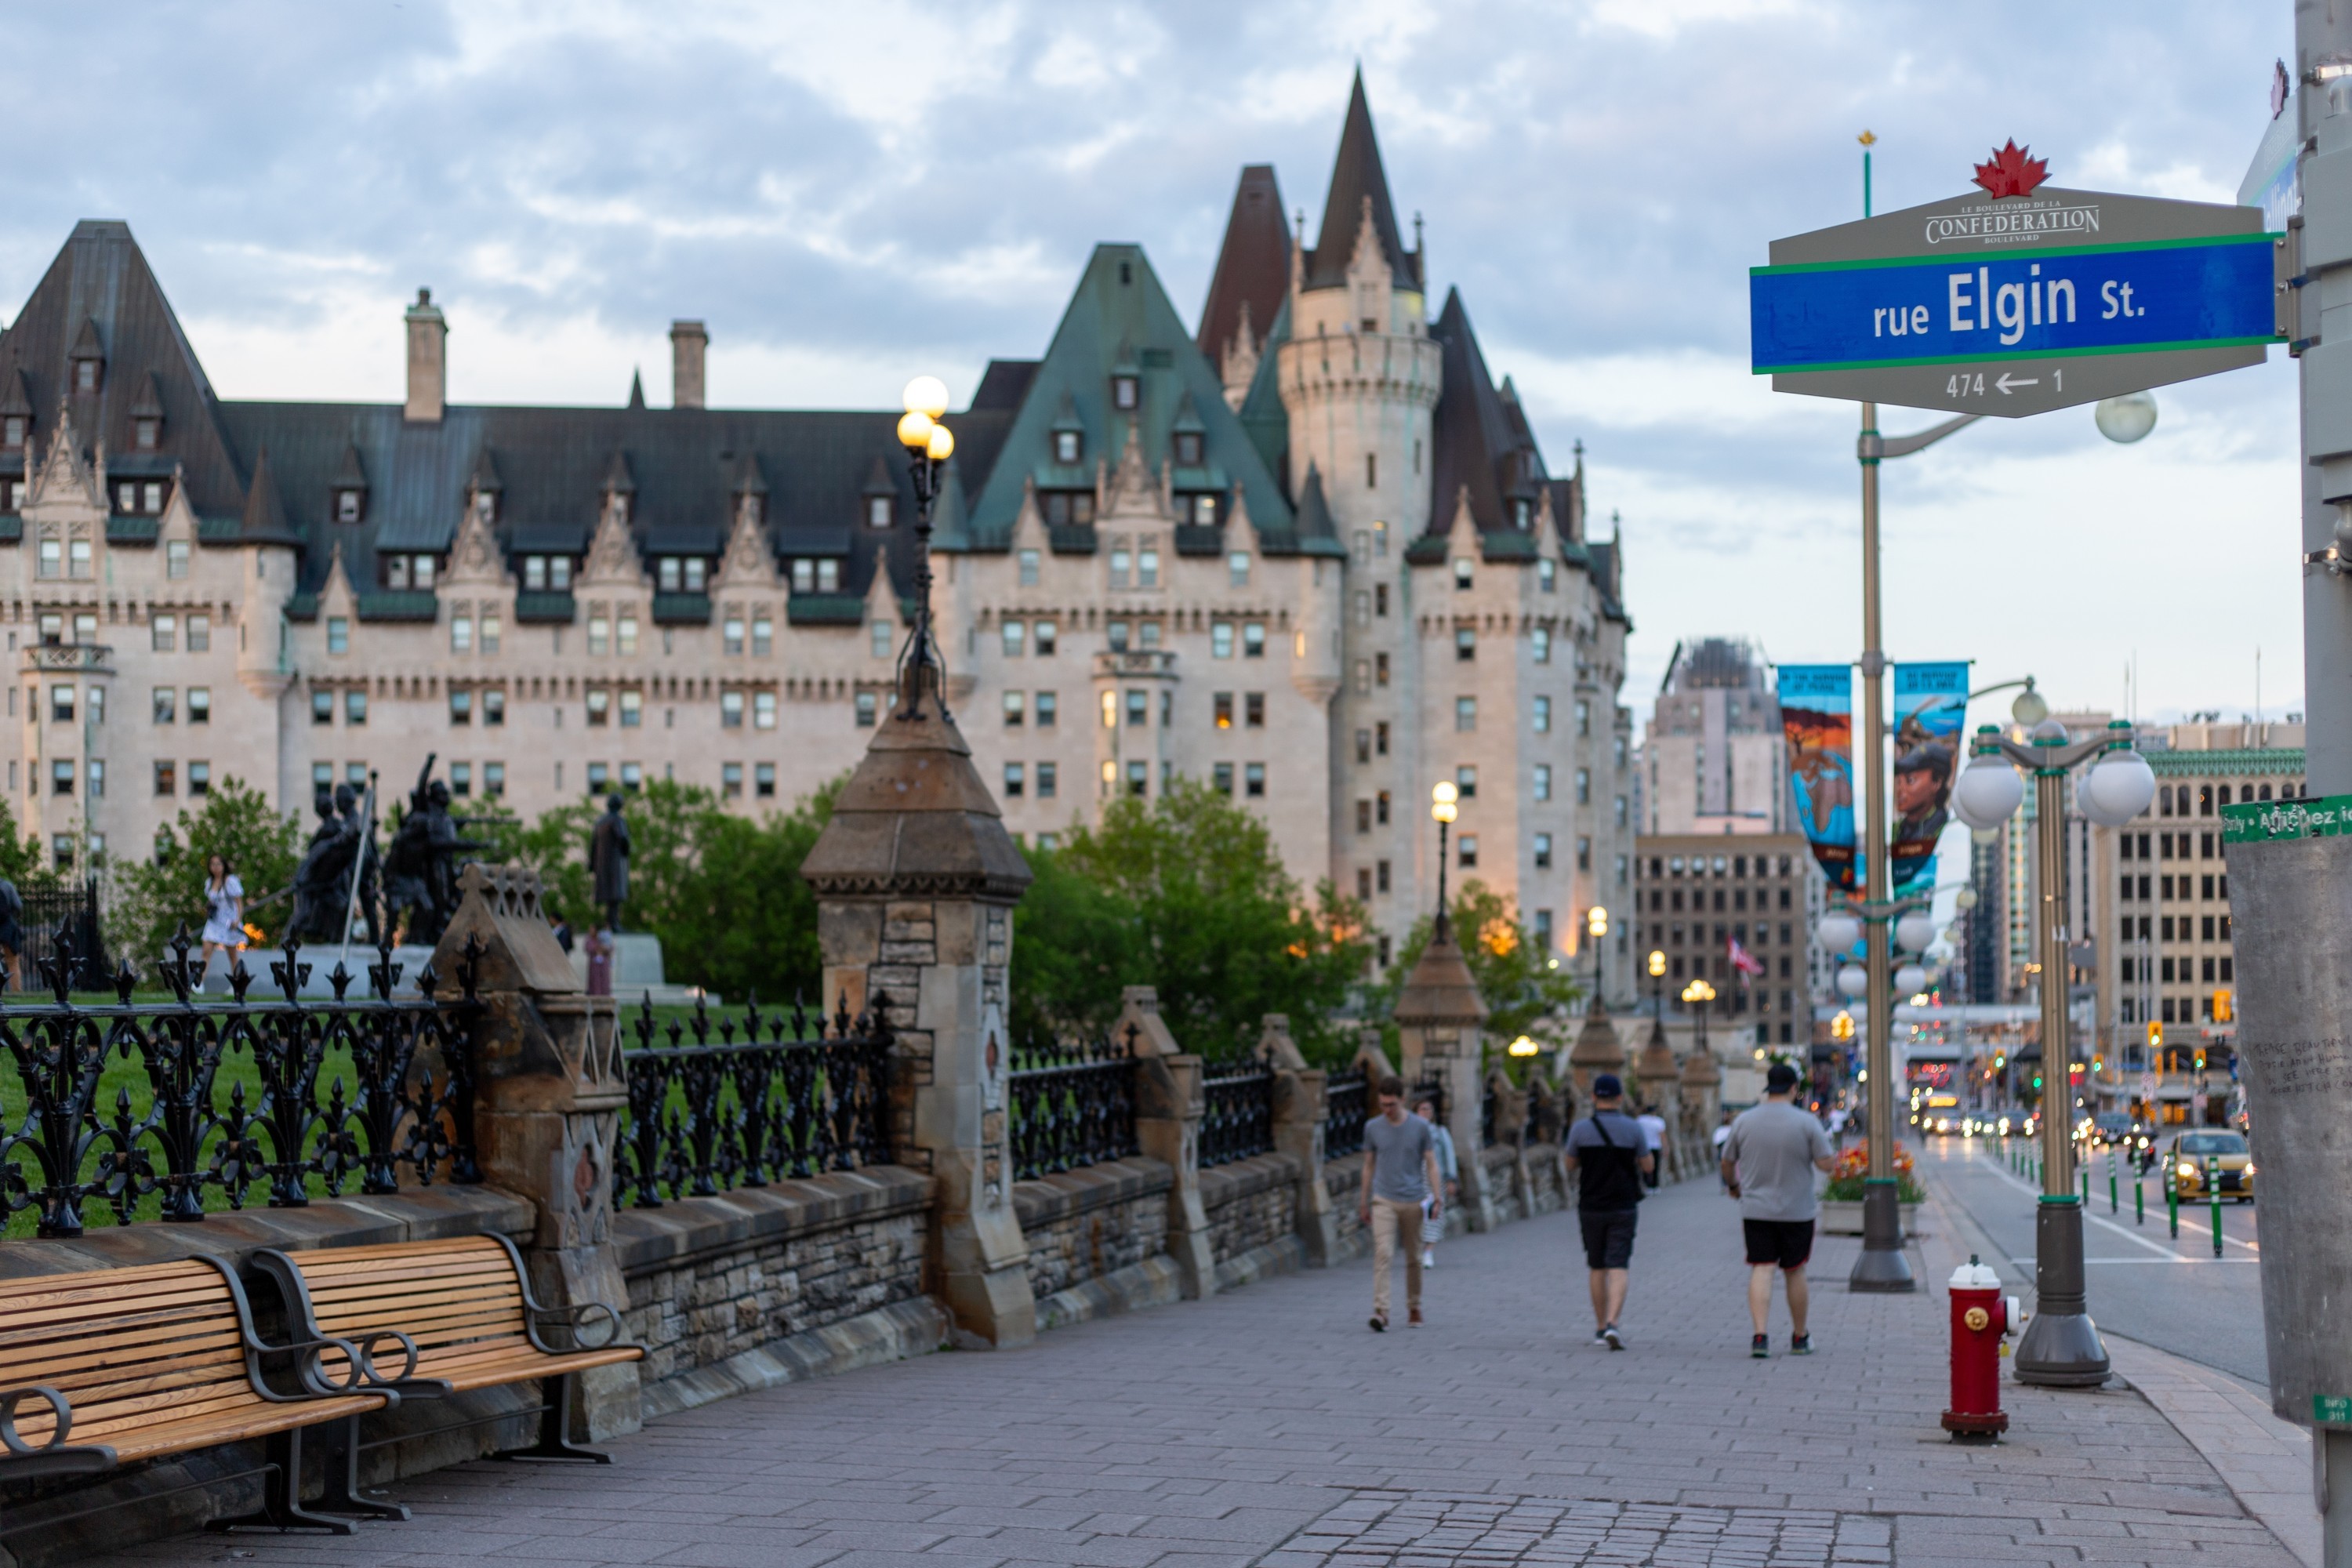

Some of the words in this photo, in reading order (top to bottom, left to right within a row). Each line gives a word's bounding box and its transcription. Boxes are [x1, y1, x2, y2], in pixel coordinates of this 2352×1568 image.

[1976, 201, 2031, 212] BOULEVARD
[1984, 234, 2040, 244] BOULEVARD
[1874, 305, 1929, 338] rue
[1948, 263, 2076, 346] Elgin
[2100, 279, 2145, 320] St.
[1947, 372, 1985, 397] 474
[2053, 368, 2063, 393] 1
[2325, 1399, 2348, 1409] INFO
[2328, 1411, 2346, 1421] 311
